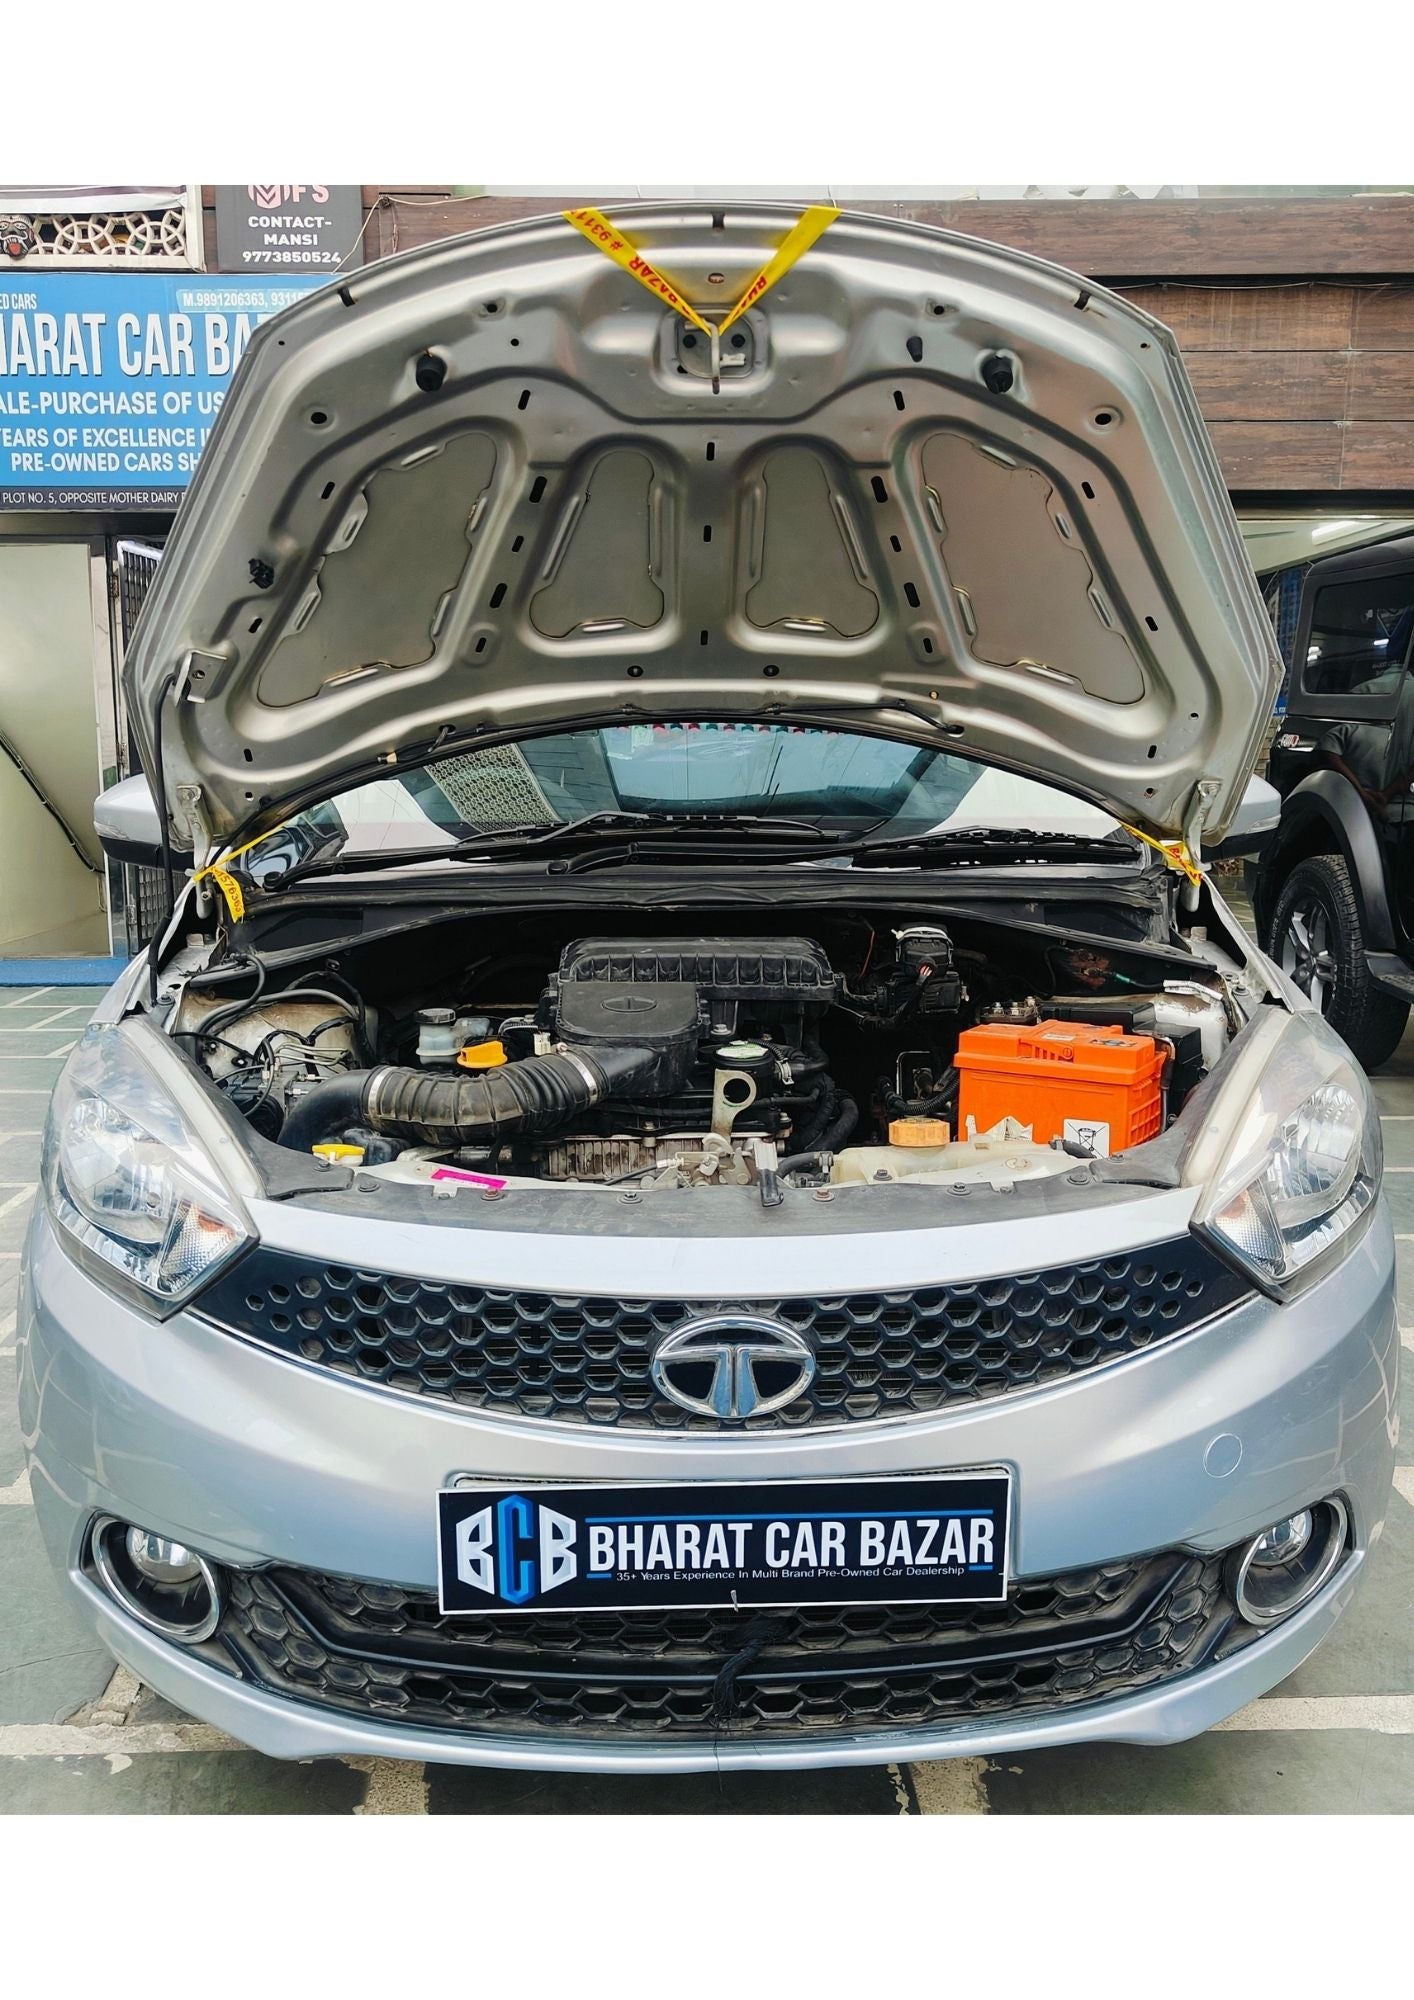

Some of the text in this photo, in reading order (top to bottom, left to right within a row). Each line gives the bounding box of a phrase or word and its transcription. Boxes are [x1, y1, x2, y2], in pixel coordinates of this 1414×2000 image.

[248, 216, 332, 228] CONTACT-
[570, 209, 612, 242] 9311
[263, 233, 318, 246] MANSI
[242, 251, 342, 263] 9773850524
[11, 293, 37, 310] CARS
[271, 291, 310, 306] 9311
[117, 312, 196, 377] CAR
[204, 313, 281, 377] BA
[162, 391, 192, 415] OF
[0, 428, 49, 448] EARS
[52, 428, 78, 448] OF
[82, 428, 196, 448] EXCELLENCE
[11, 452, 120, 472] PRE-OWNED
[124, 452, 174, 472] CARS
[2, 491, 26, 504] PLOT
[27, 491, 47, 504] NO.
[48, 491, 58, 505] 5,
[58, 491, 108, 504] OPPOSITE
[109, 491, 150, 504] MOTHER
[150, 491, 180, 504] DAIRY
[213, 867, 243, 913] 1576363
[455, 1494, 578, 1605] BCB
[588, 1517, 995, 1572] BHARAT CAR BAZAR
[616, 1565, 965, 1582] 35+ Years Experience In Multi Brand Pre-Owned Car Dealership
